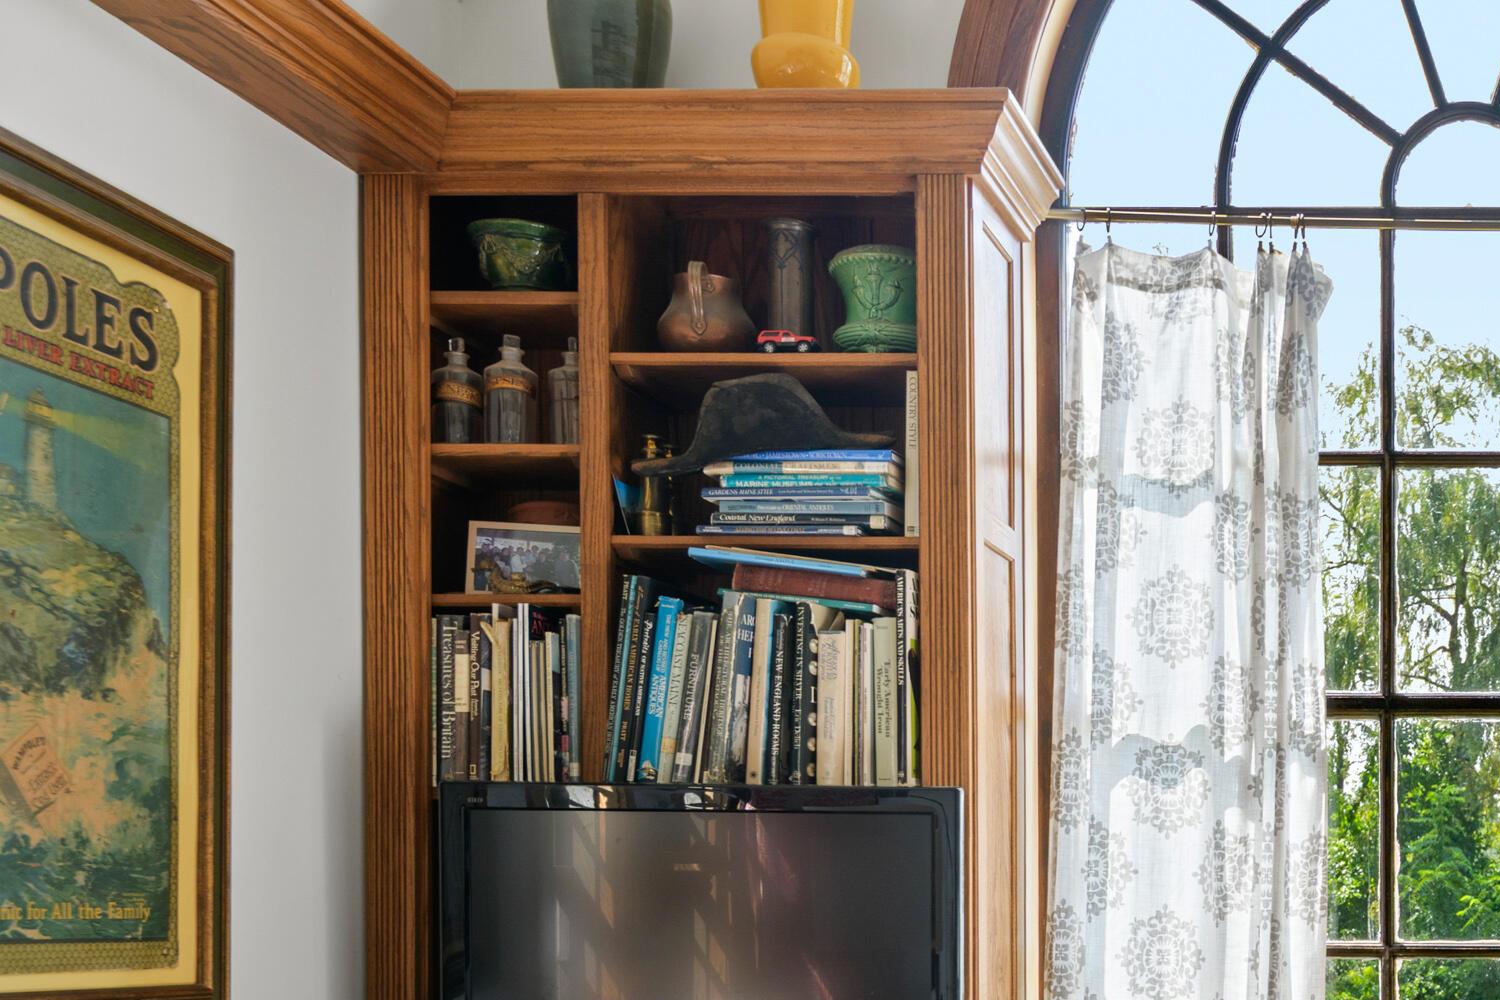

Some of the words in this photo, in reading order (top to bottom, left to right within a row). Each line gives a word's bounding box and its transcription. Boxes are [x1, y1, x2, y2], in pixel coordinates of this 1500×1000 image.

[3, 325, 64, 366] LIVER
[69, 351, 156, 400] EXTRACT
[909, 377, 918, 419] COUNTRY
[909, 421, 917, 450] STYLE
[734, 462, 779, 470] COLONIAL
[719, 513, 746, 521] Coastal
[765, 513, 796, 523] England
[621, 581, 629, 600] PRATT
[896, 576, 904, 617] AMERICA'S
[631, 619, 641, 641] EARLY
[641, 619, 653, 654] Portraits
[796, 606, 805, 654] INVESTING
[896, 618, 904, 639] ARTS
[442, 621, 458, 689] Treasures
[469, 631, 480, 661] Visiting
[613, 643, 623, 673] TREASURY
[672, 618, 689, 672] SEACOAST
[471, 662, 479, 679] Our
[627, 644, 637, 683] AMERICAN
[638, 665, 646, 684] NATIVE
[719, 632, 731, 696] ARCHITECTURAL
[775, 650, 784, 671] NEW
[795, 656, 804, 668] IN
[442, 692, 457, 705] of
[471, 681, 479, 697] Past
[610, 680, 619, 699] EARLY
[624, 685, 633, 711] HOMES
[648, 674, 660, 715] ANTIQUES
[655, 675, 667, 718] AMERICAN
[668, 674, 682, 709] MAINE
[683, 653, 698, 721] FURNITURE
[773, 675, 782, 721] ENGLAND
[794, 670, 803, 700] SILVER
[635, 685, 644, 716] AMERICANS
[884, 690, 892, 738] American
[620, 721, 628, 741] PRATT
[716, 699, 727, 737] HERITAGE
[441, 710, 457, 759] Britain
[771, 724, 780, 756] ROOMS
[27, 901, 48, 920] for
[51, 901, 73, 920] All
[79, 901, 103, 920] the
[107, 900, 151, 923] Family
